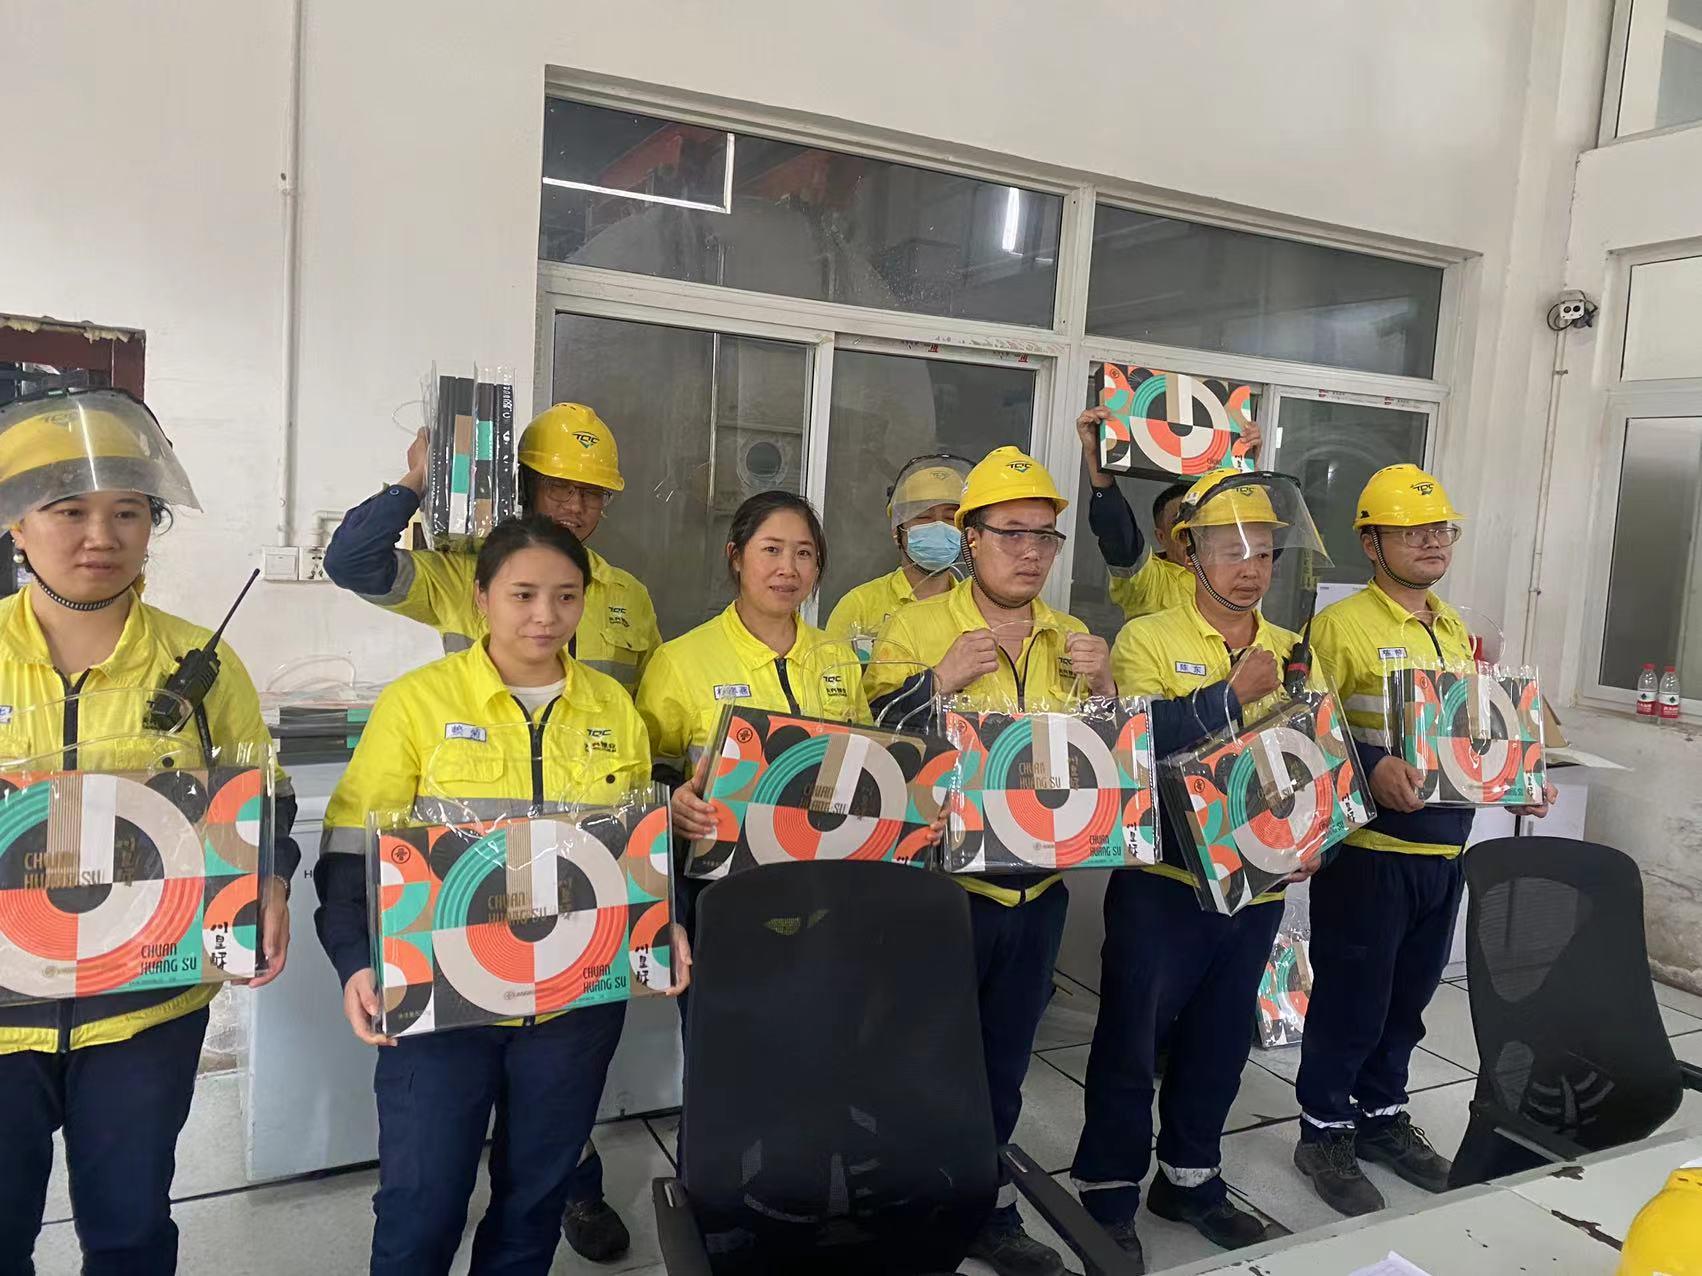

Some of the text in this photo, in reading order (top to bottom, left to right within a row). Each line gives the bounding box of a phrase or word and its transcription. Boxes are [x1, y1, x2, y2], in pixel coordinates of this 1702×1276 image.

[140, 942, 178, 959] CHUAN
[140, 956, 198, 976] HUANG SU
[582, 963, 611, 980] CHUAN
[582, 975, 627, 995] HUANG SU
